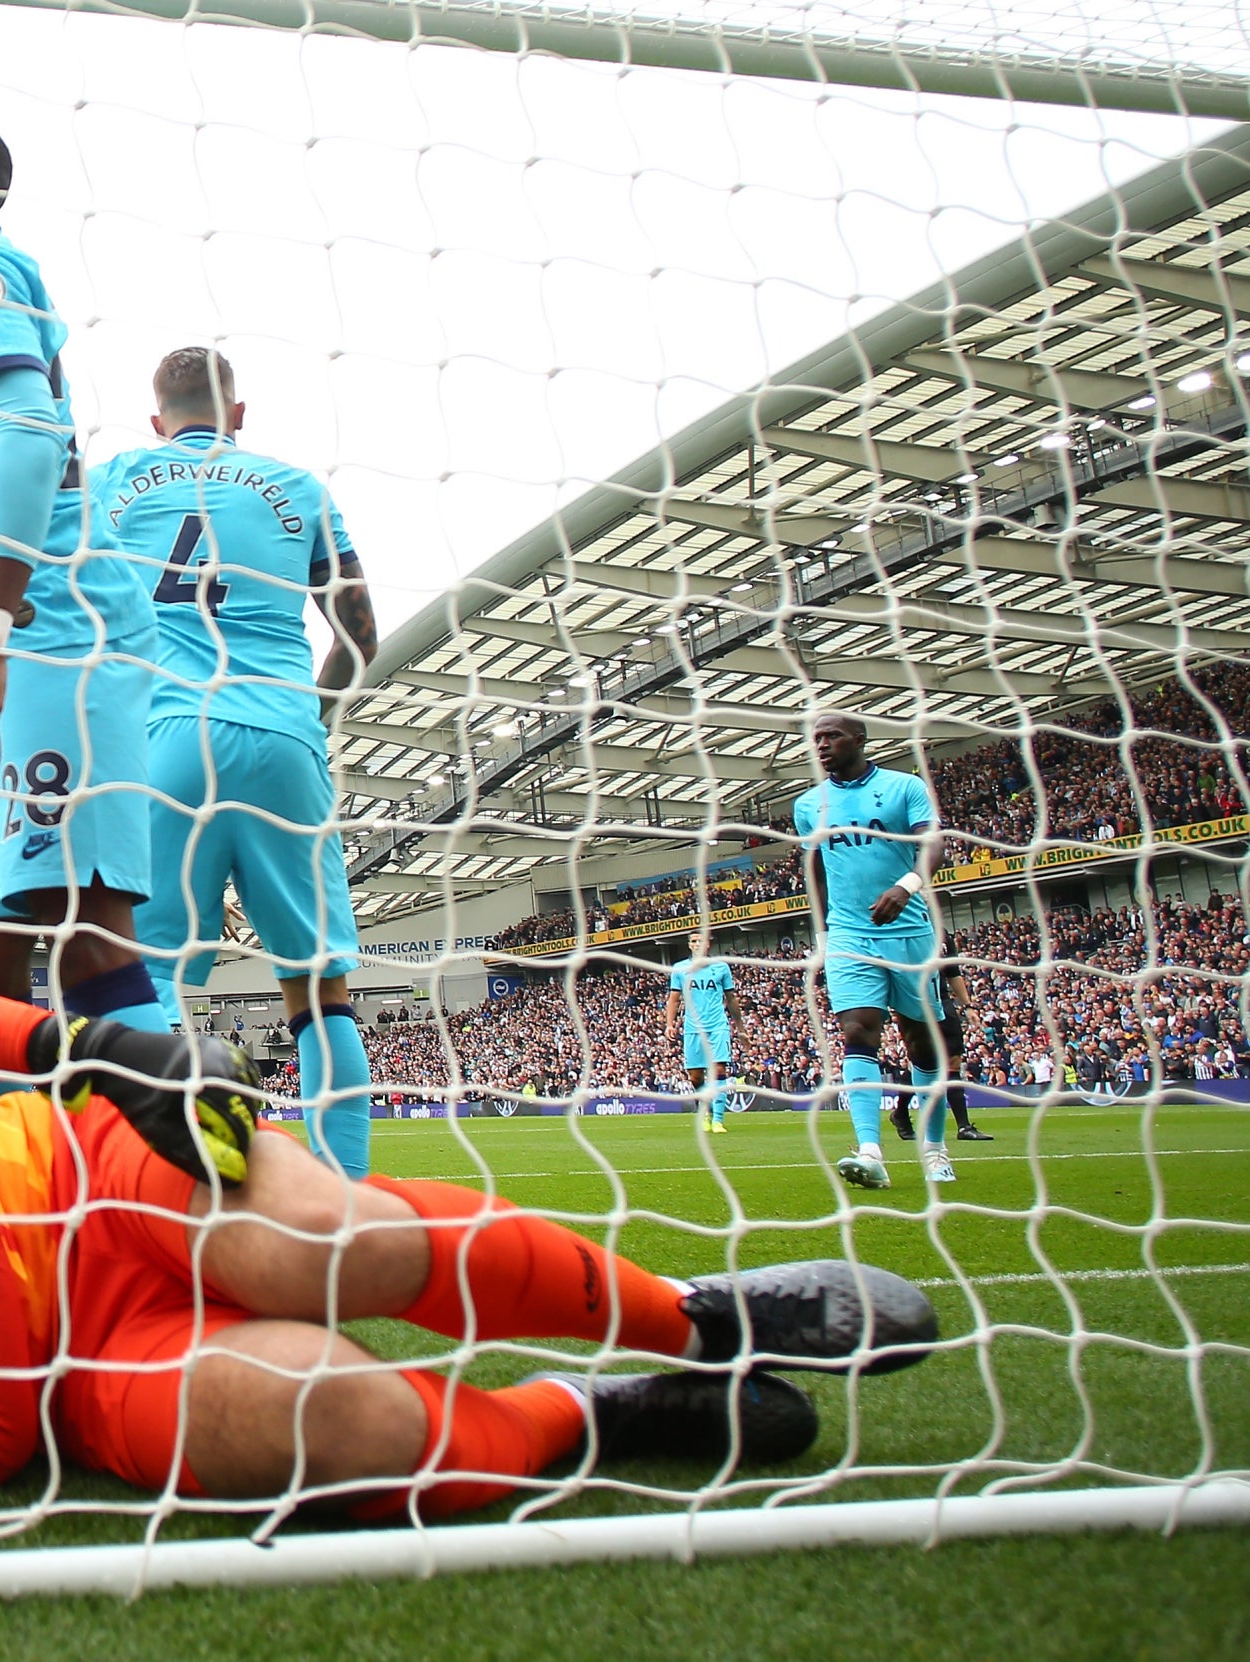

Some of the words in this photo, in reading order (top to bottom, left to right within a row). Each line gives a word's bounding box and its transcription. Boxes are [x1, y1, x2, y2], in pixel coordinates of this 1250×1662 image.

[109, 463, 303, 534] ALDERWEIRELD
[153, 513, 230, 620] 4
[0, 749, 72, 844] 28
[829, 818, 893, 850] AIA
[622, 907, 751, 938] WWW.BRIGHTONTOLS.CO.UK
[690, 979, 718, 991] AIA
[595, 1099, 625, 1115] apollo
[625, 1102, 656, 1114] TYRES
